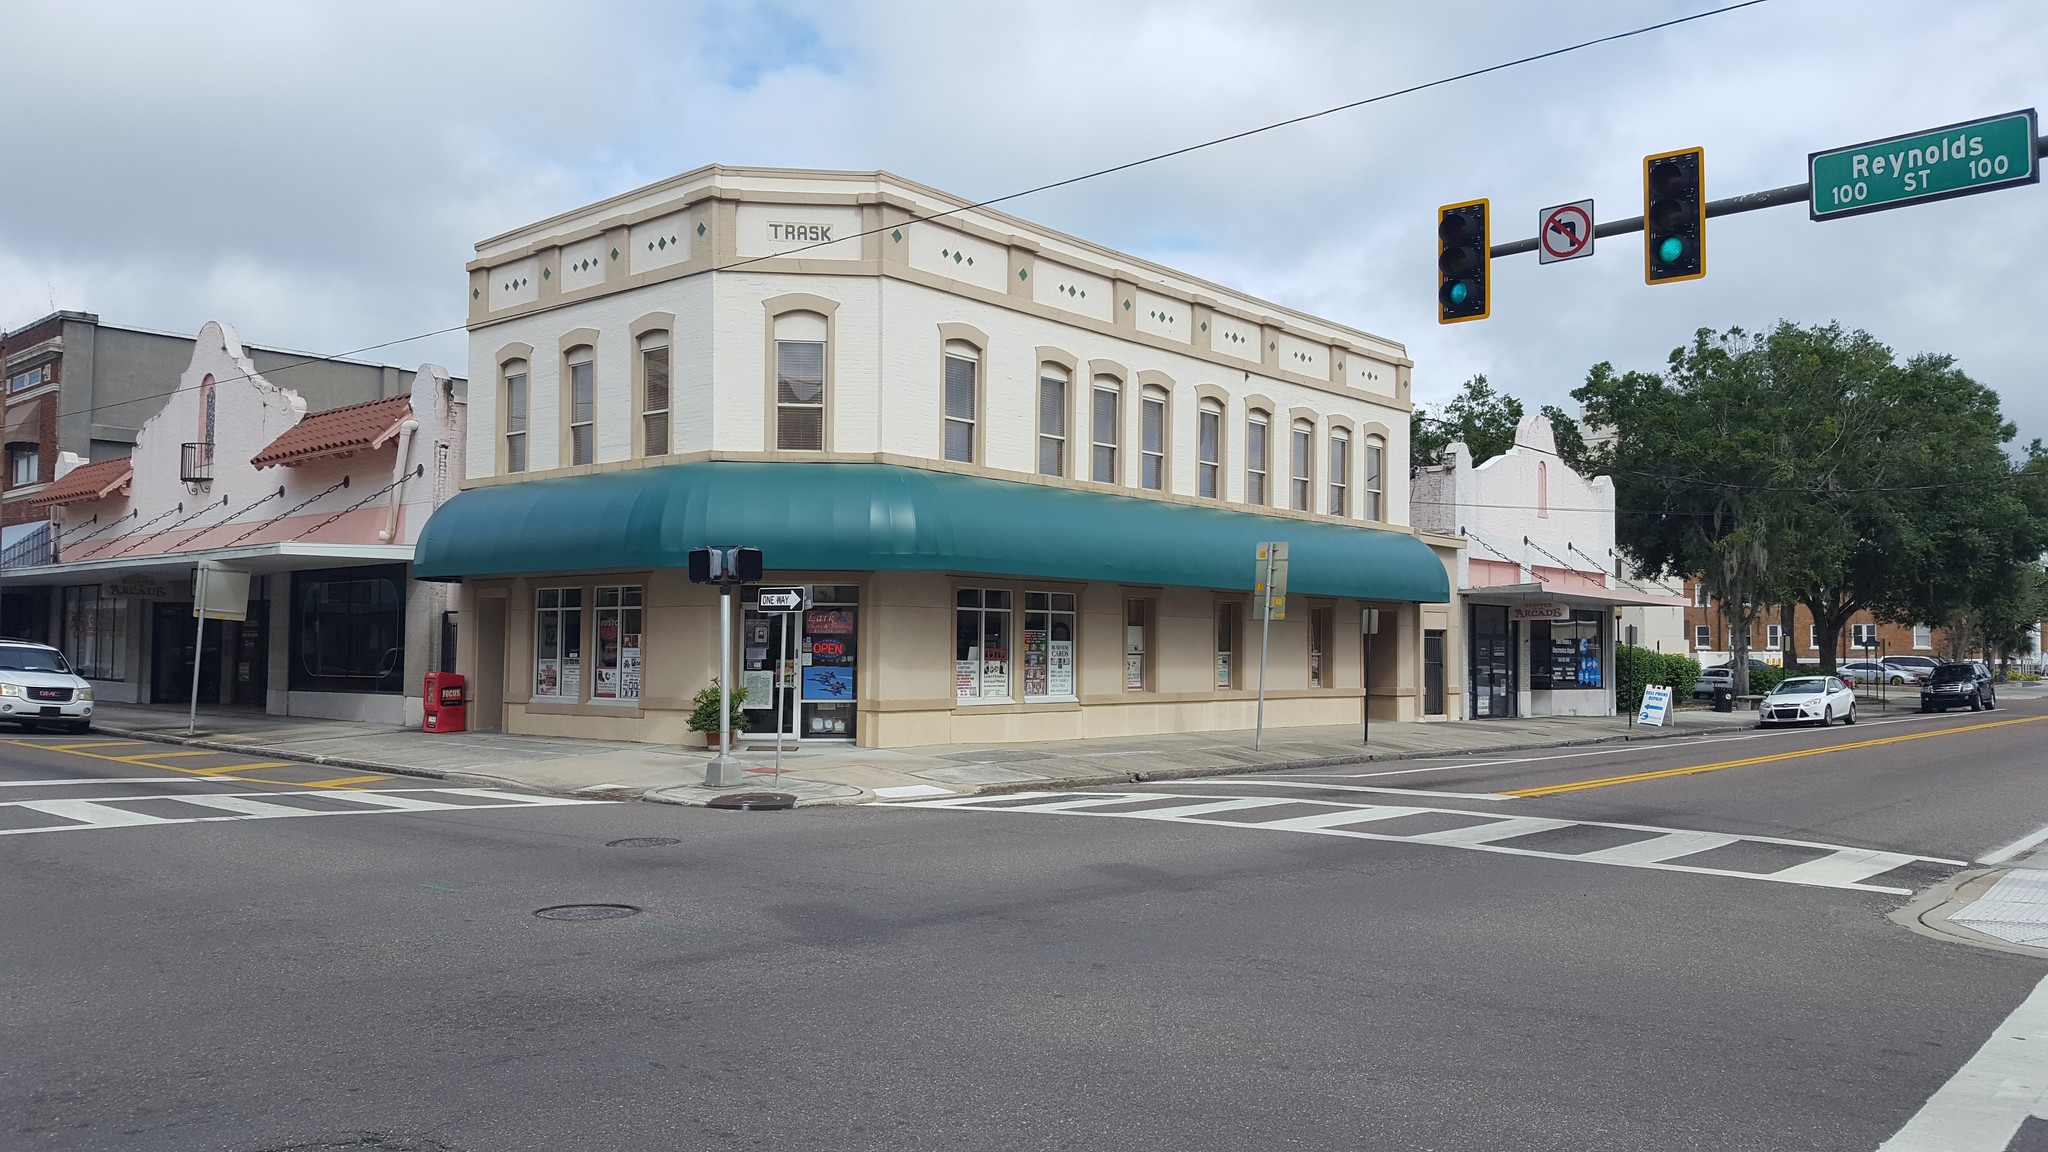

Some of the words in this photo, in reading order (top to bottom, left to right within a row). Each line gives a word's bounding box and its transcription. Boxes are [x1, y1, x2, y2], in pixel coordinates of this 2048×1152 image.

[1853, 134, 1983, 178] Reynolds
[1832, 181, 1868, 204] 100
[1904, 169, 1931, 192] ST
[1969, 155, 2008, 179] 100
[768, 224, 832, 242] TRASK
[762, 596, 774, 605] ONE
[776, 596, 789, 605] WAY
[808, 611, 836, 625] Lark
[1514, 608, 1563, 618] ARCADE
[600, 619, 618, 627] CUSTO
[813, 643, 843, 655] OPEN
[442, 689, 461, 698] FOCUS
